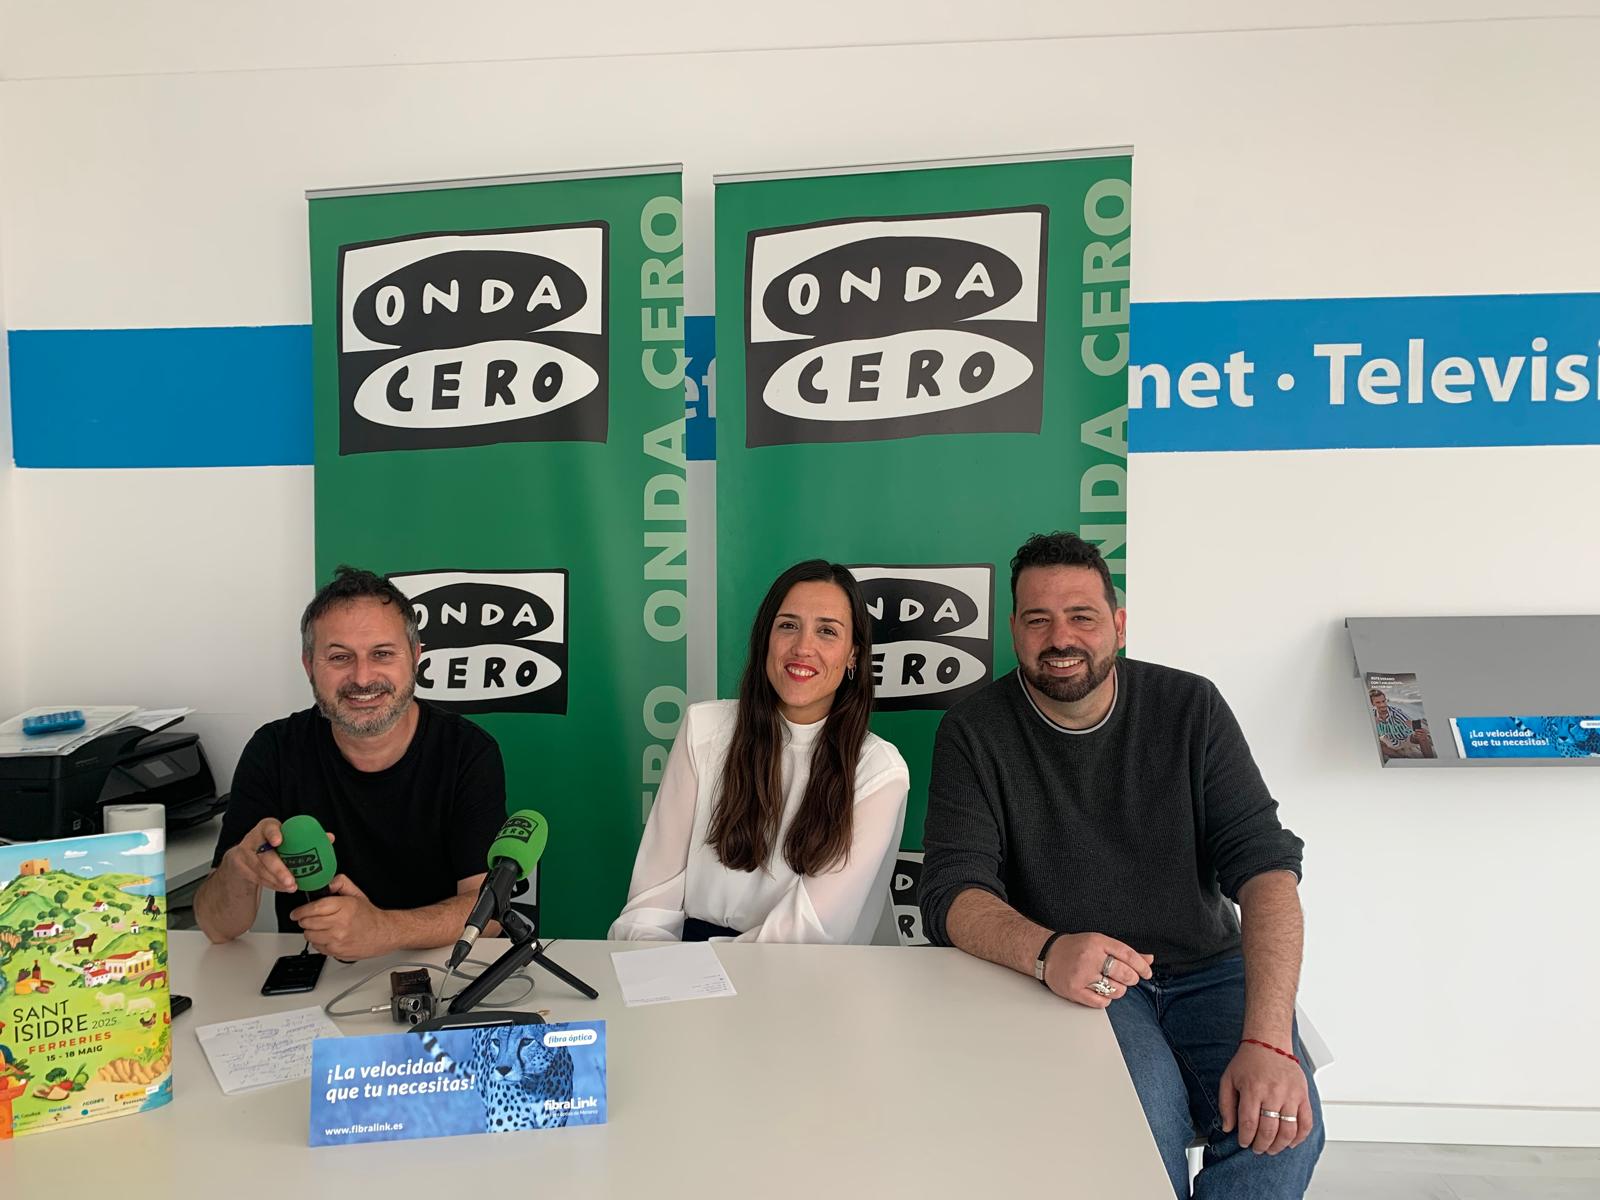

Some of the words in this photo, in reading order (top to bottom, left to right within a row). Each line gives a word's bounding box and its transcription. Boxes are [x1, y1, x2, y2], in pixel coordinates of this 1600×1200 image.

[640, 195, 685, 390] CERO
[788, 261, 995, 316] ONDA
[1080, 178, 1133, 377] CERO
[375, 274, 562, 326] ONDA
[385, 359, 564, 412] CERO
[797, 348, 996, 404] CERO
[1129, 350, 1255, 409] net
[1313, 336, 1600, 405] Televis
[1080, 402, 1127, 608] NDA
[643, 416, 688, 641] ONDA
[866, 596, 961, 623] NDA
[416, 656, 539, 689] CERO
[871, 652, 961, 686] ERO
[1471, 739, 1489, 748] que
[1491, 738, 1501, 746] tu
[1503, 737, 1550, 746] necesitas!
[1486, 729, 1531, 738] velocidad
[13, 999, 69, 1024] SANT
[14, 1013, 88, 1044] ISIDRE
[92, 1016, 118, 1030] 2025
[28, 1031, 112, 1056] FERRERIES
[548, 1035, 567, 1044] fibra
[568, 1032, 593, 1043] óptica
[47, 1054, 56, 1062] 15
[78, 1044, 103, 1056] MAIG
[327, 1064, 356, 1085] ¡La
[360, 1057, 446, 1078] velocidad
[325, 1086, 359, 1104] que
[364, 1082, 383, 1098] tu
[387, 1074, 476, 1097] necesitas!
[544, 1096, 598, 1111] fibraLink
[325, 1122, 404, 1136] www.fibralink.es
